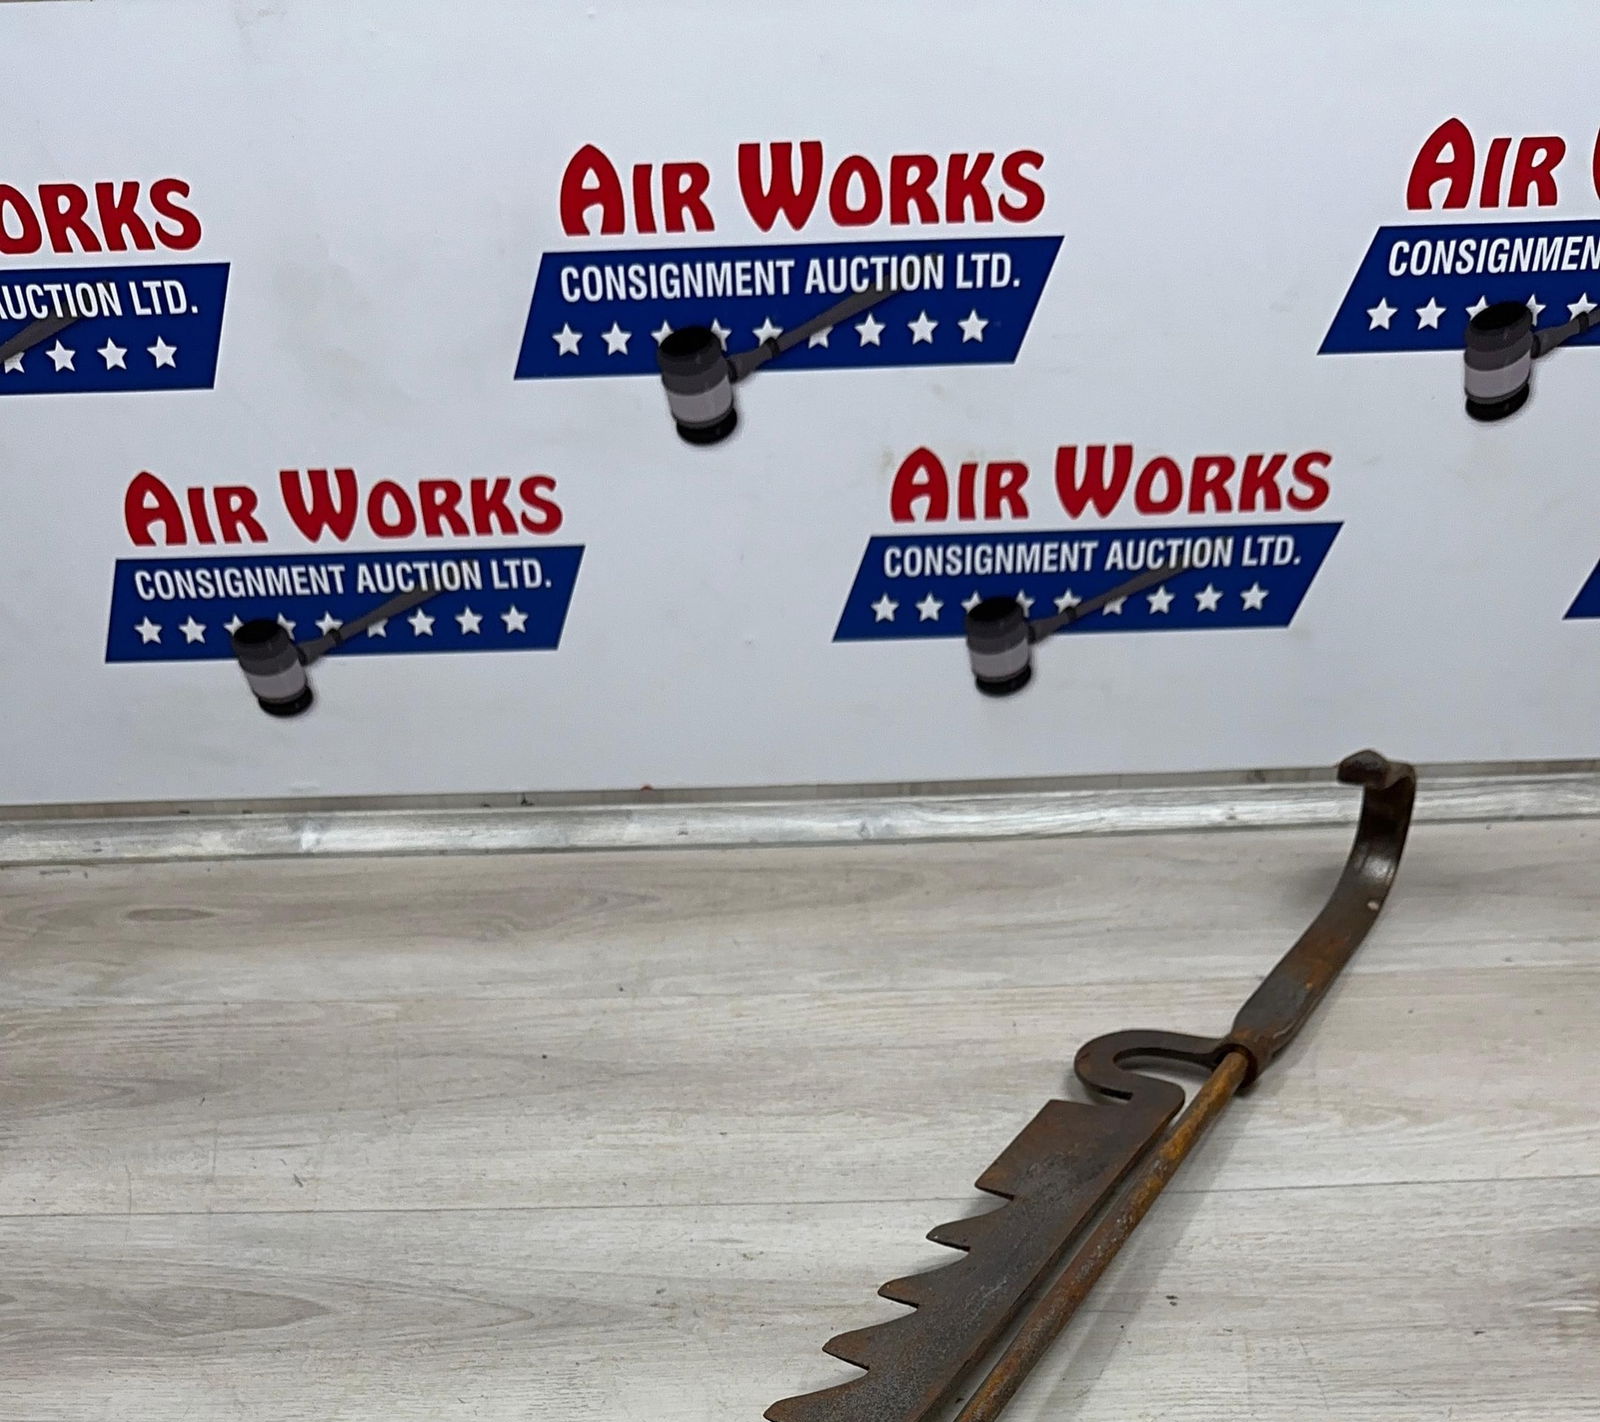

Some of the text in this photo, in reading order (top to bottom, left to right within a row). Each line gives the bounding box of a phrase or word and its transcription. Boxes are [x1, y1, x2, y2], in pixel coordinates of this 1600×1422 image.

[560, 140, 1046, 236] AIR WORKS
[1406, 117, 1567, 211] AIR
[0, 178, 203, 255] ORKS
[560, 252, 1021, 303] CONSIGNMENT AUCTION LTD.
[1388, 235, 1600, 277] CONSIGNMEN
[0, 280, 200, 320] UCTION LTD.
[124, 468, 563, 546] AIR WORKS
[890, 444, 1333, 522] AIR WORKS
[134, 559, 553, 600] CONSIGNMENT AUCTION LTD.
[884, 535, 1301, 578] CONSIGNMENT AUCTION LTD.
